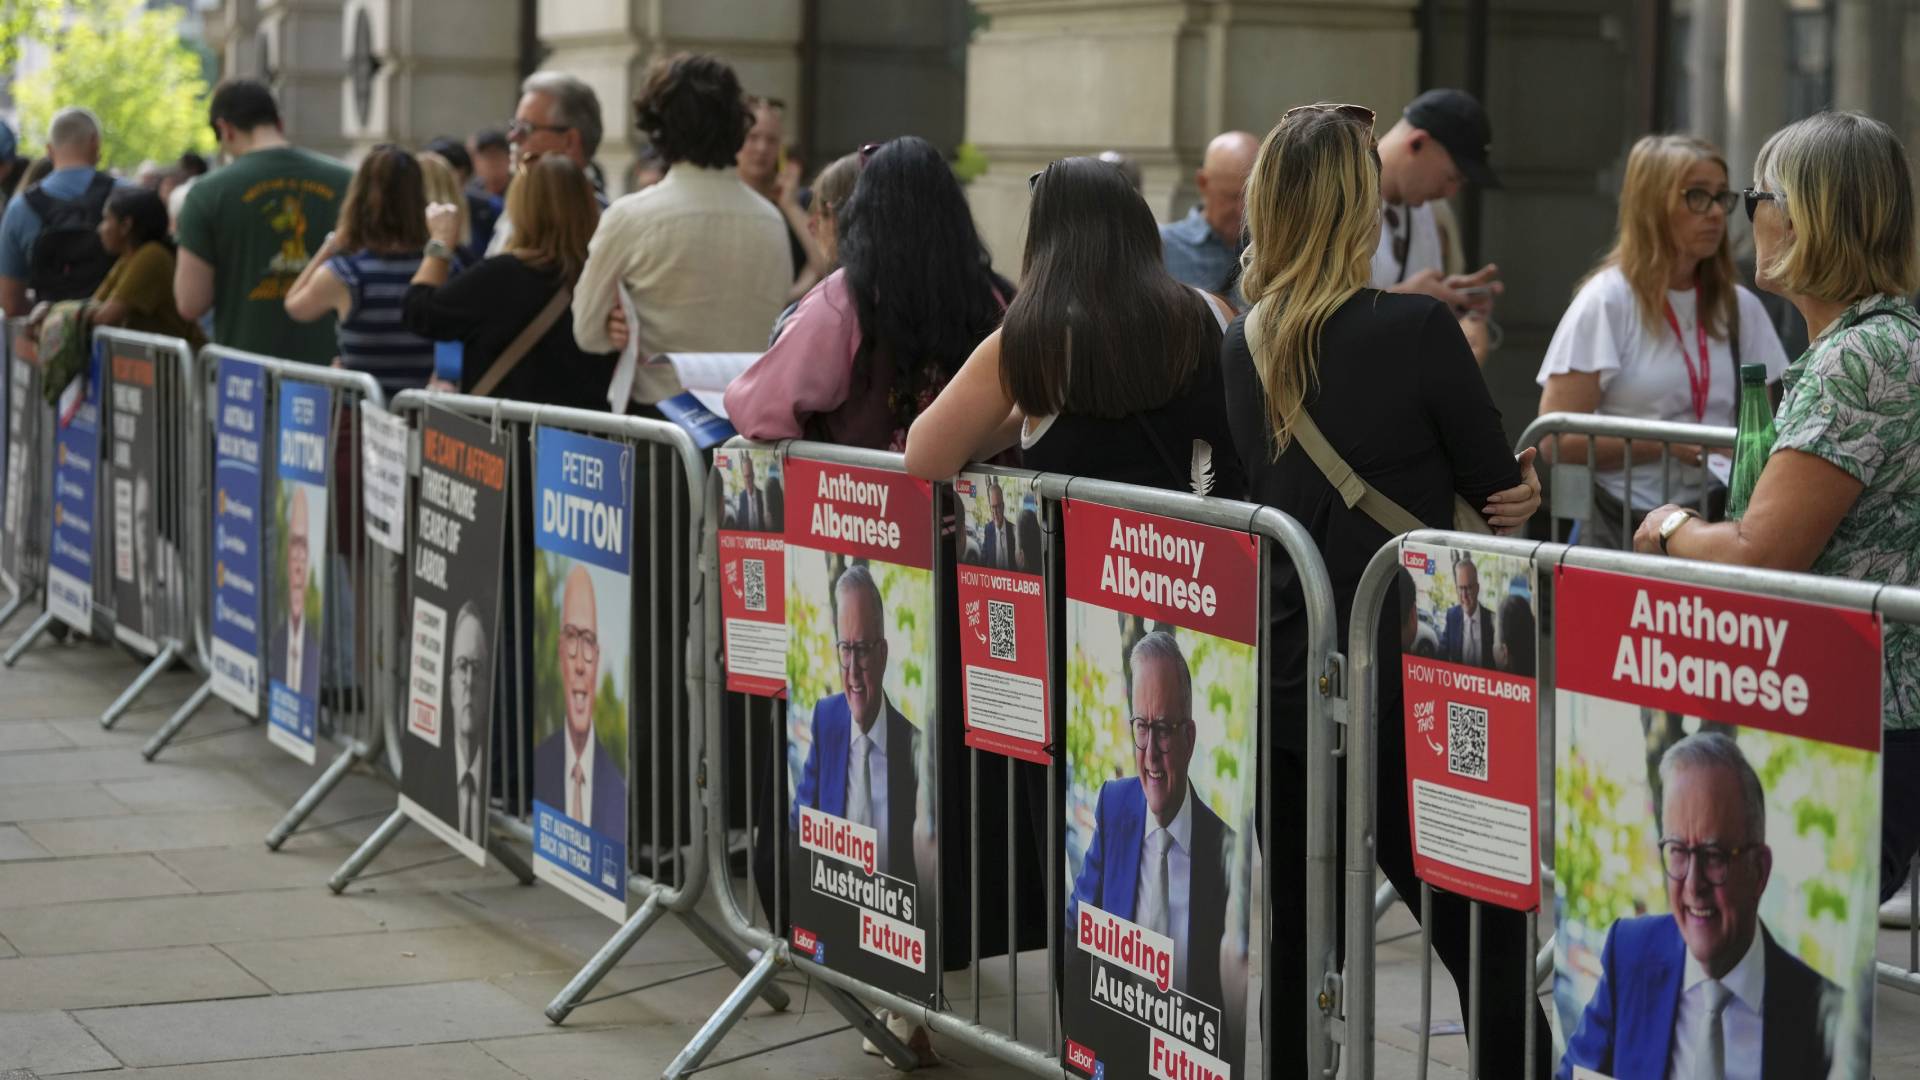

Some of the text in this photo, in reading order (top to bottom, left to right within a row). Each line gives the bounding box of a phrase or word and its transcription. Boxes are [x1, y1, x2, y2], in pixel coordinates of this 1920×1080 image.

[281, 428, 325, 473] DUTTON
[465, 445, 504, 491] AFFORD
[562, 450, 603, 491] PETER
[422, 466, 449, 510] THREE
[450, 477, 477, 522] MORE
[818, 470, 889, 518] Anthony
[419, 504, 448, 549] YEARS
[448, 517, 462, 555] OF
[543, 488, 623, 554] DUTTON
[744, 537, 762, 550] VOTE
[810, 503, 900, 549] Albanese
[1110, 518, 1205, 579] Anthony
[1405, 552, 1425, 567] Labor
[961, 571, 1040, 596] HOW TO VOTE LABOR
[1101, 554, 1217, 617] Albanese
[965, 600, 980, 616] SCAN
[1630, 588, 1789, 668] Anthony
[1408, 663, 1531, 703] HOW TO VOTE LABOR
[1612, 635, 1809, 716] Albanese
[1413, 700, 1435, 718] SCAN
[1417, 716, 1435, 733] THIS
[802, 814, 874, 875] Building
[814, 859, 913, 921] Australia's
[794, 929, 815, 950] Labor
[863, 914, 922, 965] Future
[1080, 911, 1170, 992] Building
[1094, 965, 1216, 1051] Australia's
[1068, 1043, 1092, 1069] Labor
